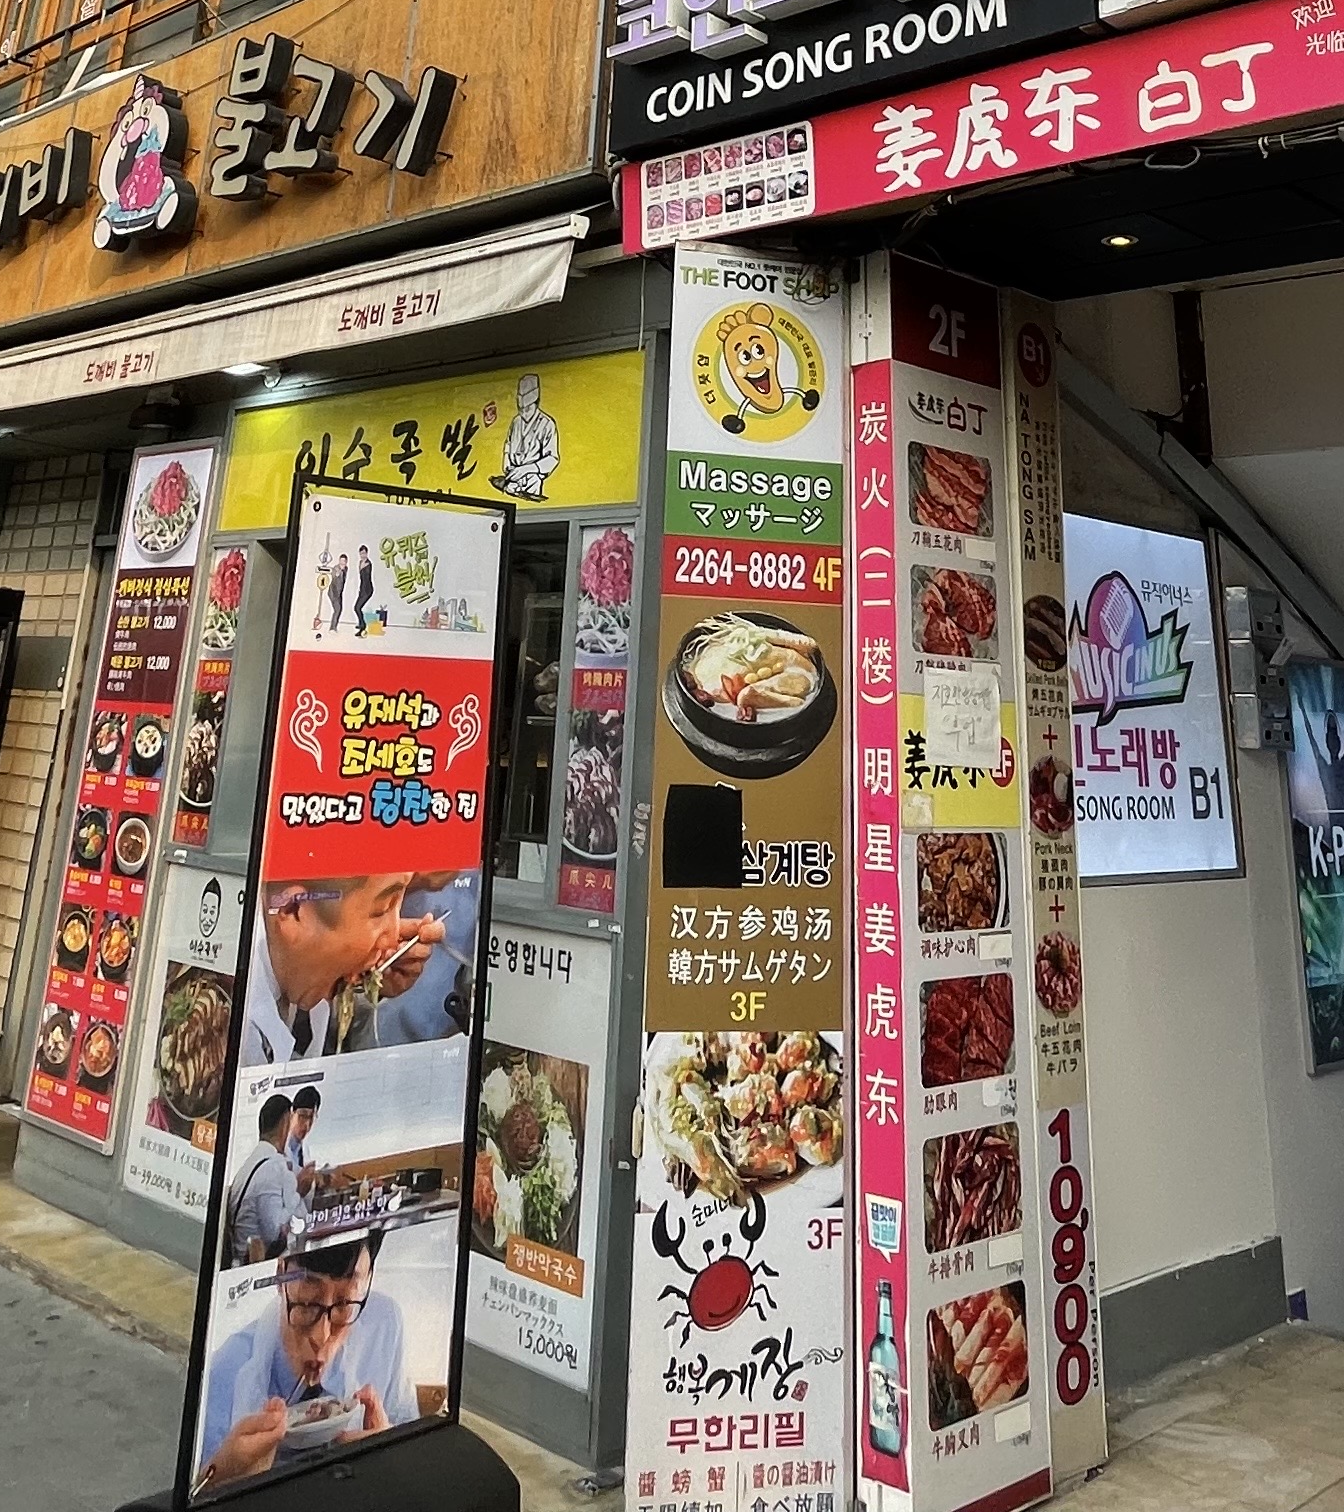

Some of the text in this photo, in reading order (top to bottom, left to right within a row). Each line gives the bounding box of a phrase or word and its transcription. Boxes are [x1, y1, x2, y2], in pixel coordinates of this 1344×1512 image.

[645, 68, 735, 124] COIN
[741, 33, 854, 94] SONG
[210, 33, 441, 200] 불고기
[871, 41, 1275, 193] 姜虎东 白丁
[679, 265, 779, 293] THE FOOT
[337, 289, 442, 333] 도깨비 불고기
[928, 304, 966, 358] 2F
[83, 350, 156, 383] 도깨비 불고기
[1022, 334, 1045, 363] B1
[946, 396, 988, 436] 白丁
[679, 460, 833, 502] Massage
[1019, 391, 1038, 562] NA TONG SAM
[690, 502, 824, 533] マッサージ
[675, 546, 843, 592] 2264-8882 4F
[1140, 580, 1193, 606] 뮤직이너스
[153, 615, 177, 630] 12,000
[146, 655, 170, 671] 12,000
[341, 689, 441, 730] 유재석과
[340, 736, 435, 777] 조세호도
[282, 779, 479, 828] 맛있다고 칭찬한 집
[1076, 795, 1176, 822] SONG ROOM
[1189, 766, 1225, 821] B1
[742, 839, 836, 888] 삼계탕
[669, 904, 833, 942] 汉方参鸡汤
[486, 934, 574, 984] 운영합니다
[667, 947, 833, 987] 韓方サムゲタン
[730, 990, 768, 1022] 3F
[807, 1218, 843, 1251] 3F
[516, 1326, 579, 1371] 15,000원
[666, 1410, 807, 1455] 무한리필
